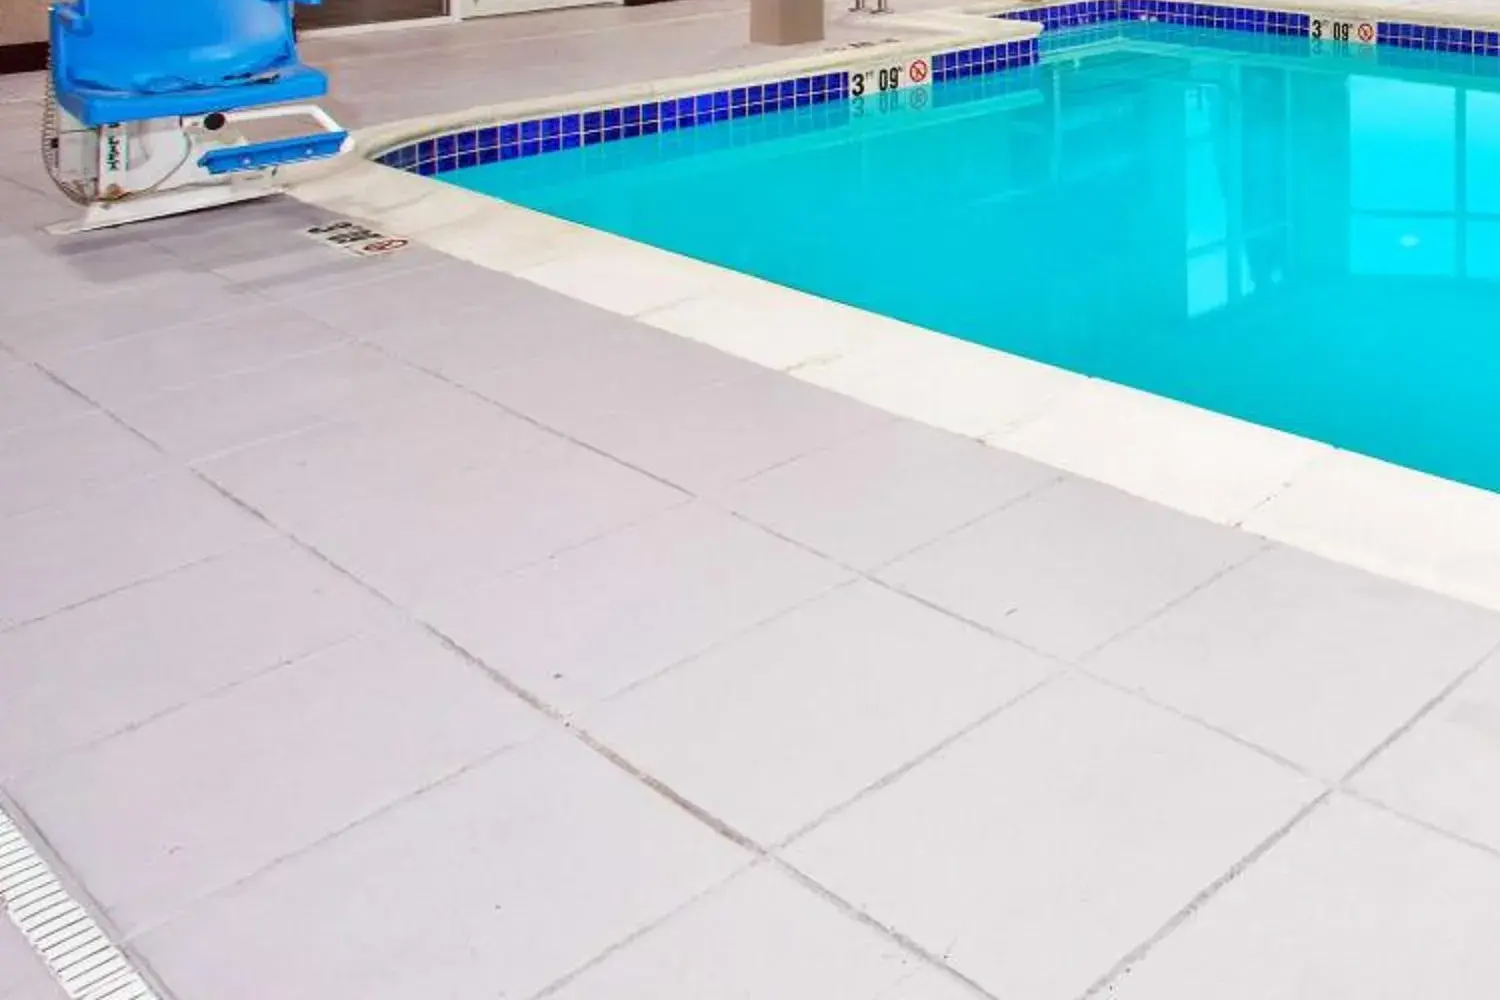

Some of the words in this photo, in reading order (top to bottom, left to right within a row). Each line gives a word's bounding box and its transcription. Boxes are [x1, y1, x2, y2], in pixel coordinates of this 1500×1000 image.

[1312, 20, 1321, 38] 3
[1333, 22, 1349, 40] 09
[852, 74, 864, 96] 3
[879, 68, 899, 91] 09
